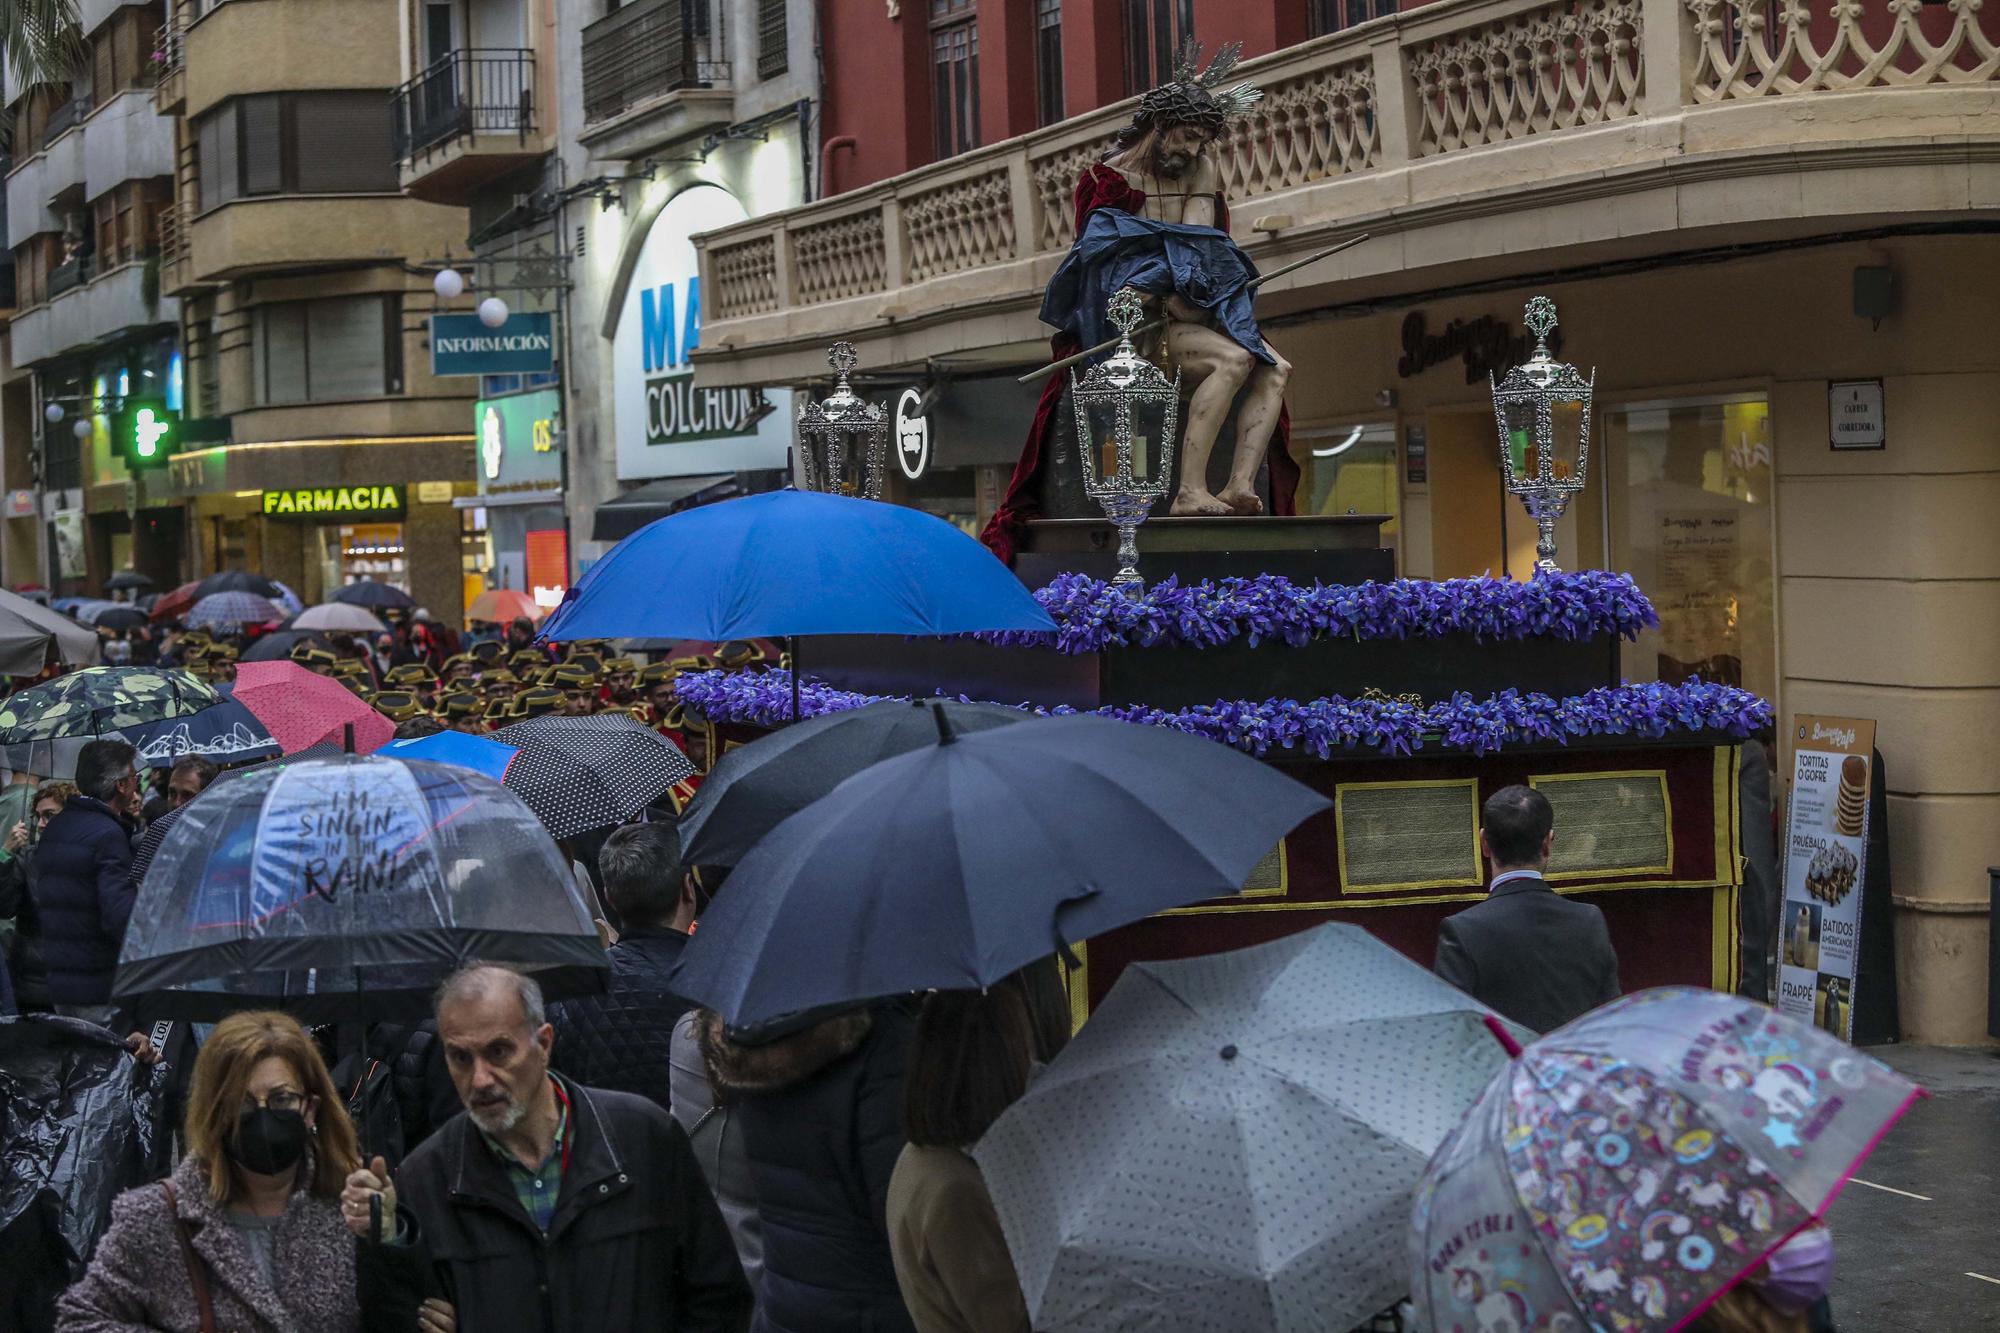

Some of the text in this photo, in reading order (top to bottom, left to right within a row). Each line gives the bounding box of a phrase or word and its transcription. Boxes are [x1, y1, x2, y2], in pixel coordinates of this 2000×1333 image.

[437, 333, 550, 353] INFORMACIÓN
[1844, 404, 1868, 413] CARRER
[1838, 422, 1876, 432] CORREDORA
[264, 486, 399, 513] FARMACIA
[1799, 755, 1829, 769] TORTITAS
[1798, 769, 1827, 782] O GOFRE
[332, 790, 369, 812] I'M
[325, 838, 342, 857] IN
[1792, 834, 1827, 850] PRUÉBALO
[303, 849, 398, 903] RAIN!
[1822, 918, 1854, 936] BATIDOS
[1821, 935, 1853, 949] AMERICANOS
[1782, 981, 1813, 1001] FRAPPÉ
